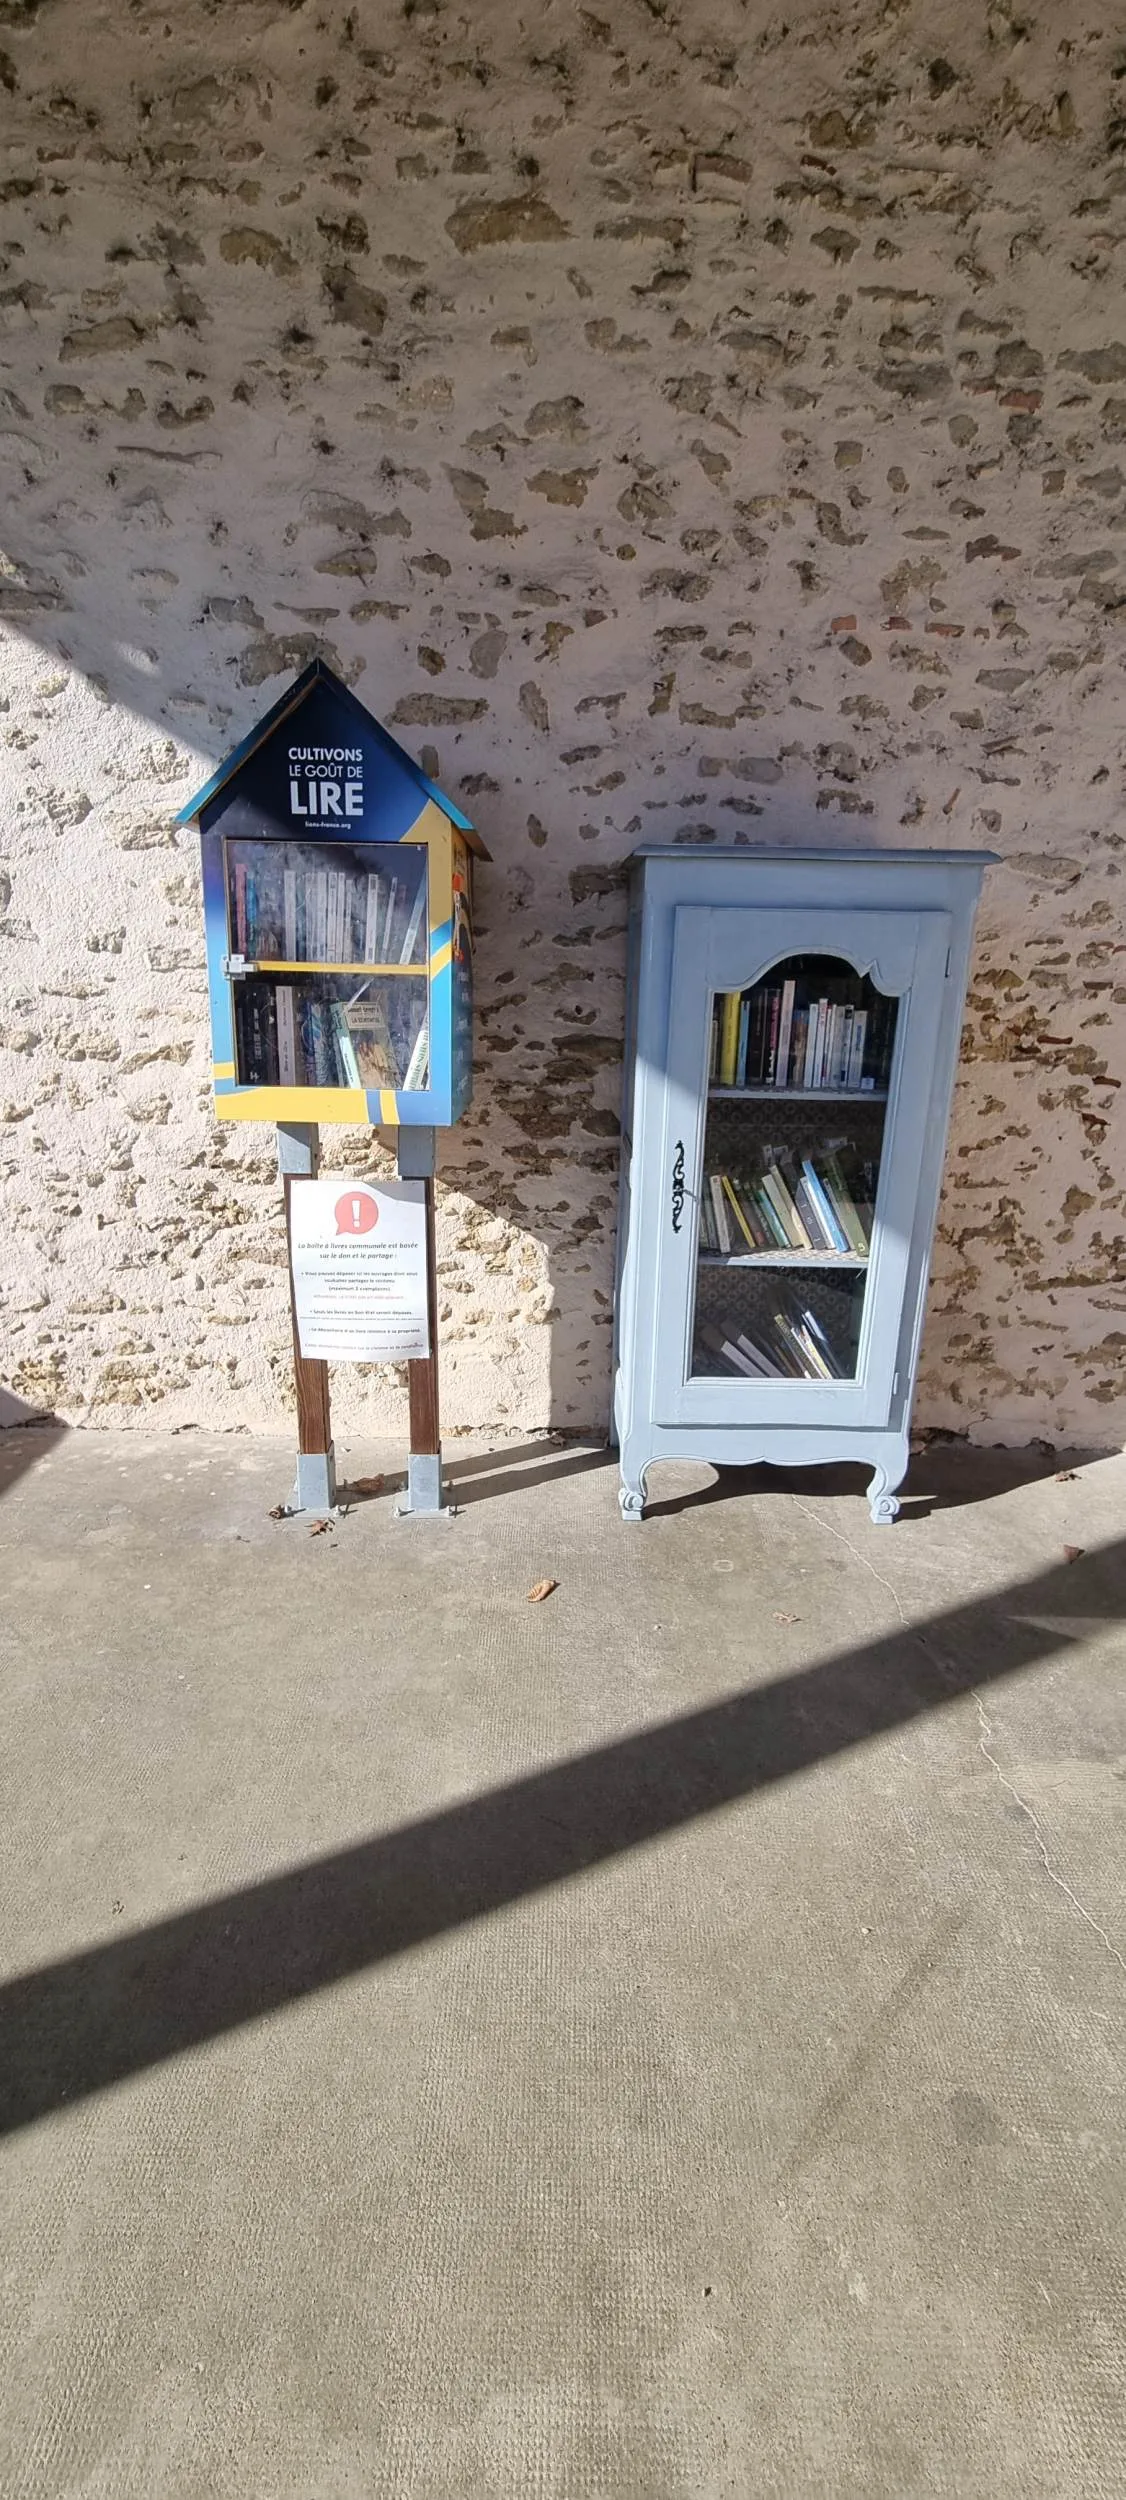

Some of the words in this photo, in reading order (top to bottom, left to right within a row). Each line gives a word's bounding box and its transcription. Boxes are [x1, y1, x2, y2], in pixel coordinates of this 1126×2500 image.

[288, 747, 363, 761] CULTIVONS
[289, 764, 301, 777] LE
[304, 762, 343, 778] GOÛT
[347, 765, 363, 778] DE
[290, 781, 364, 816] LIRE
[367, 1252, 394, 1260] partage
